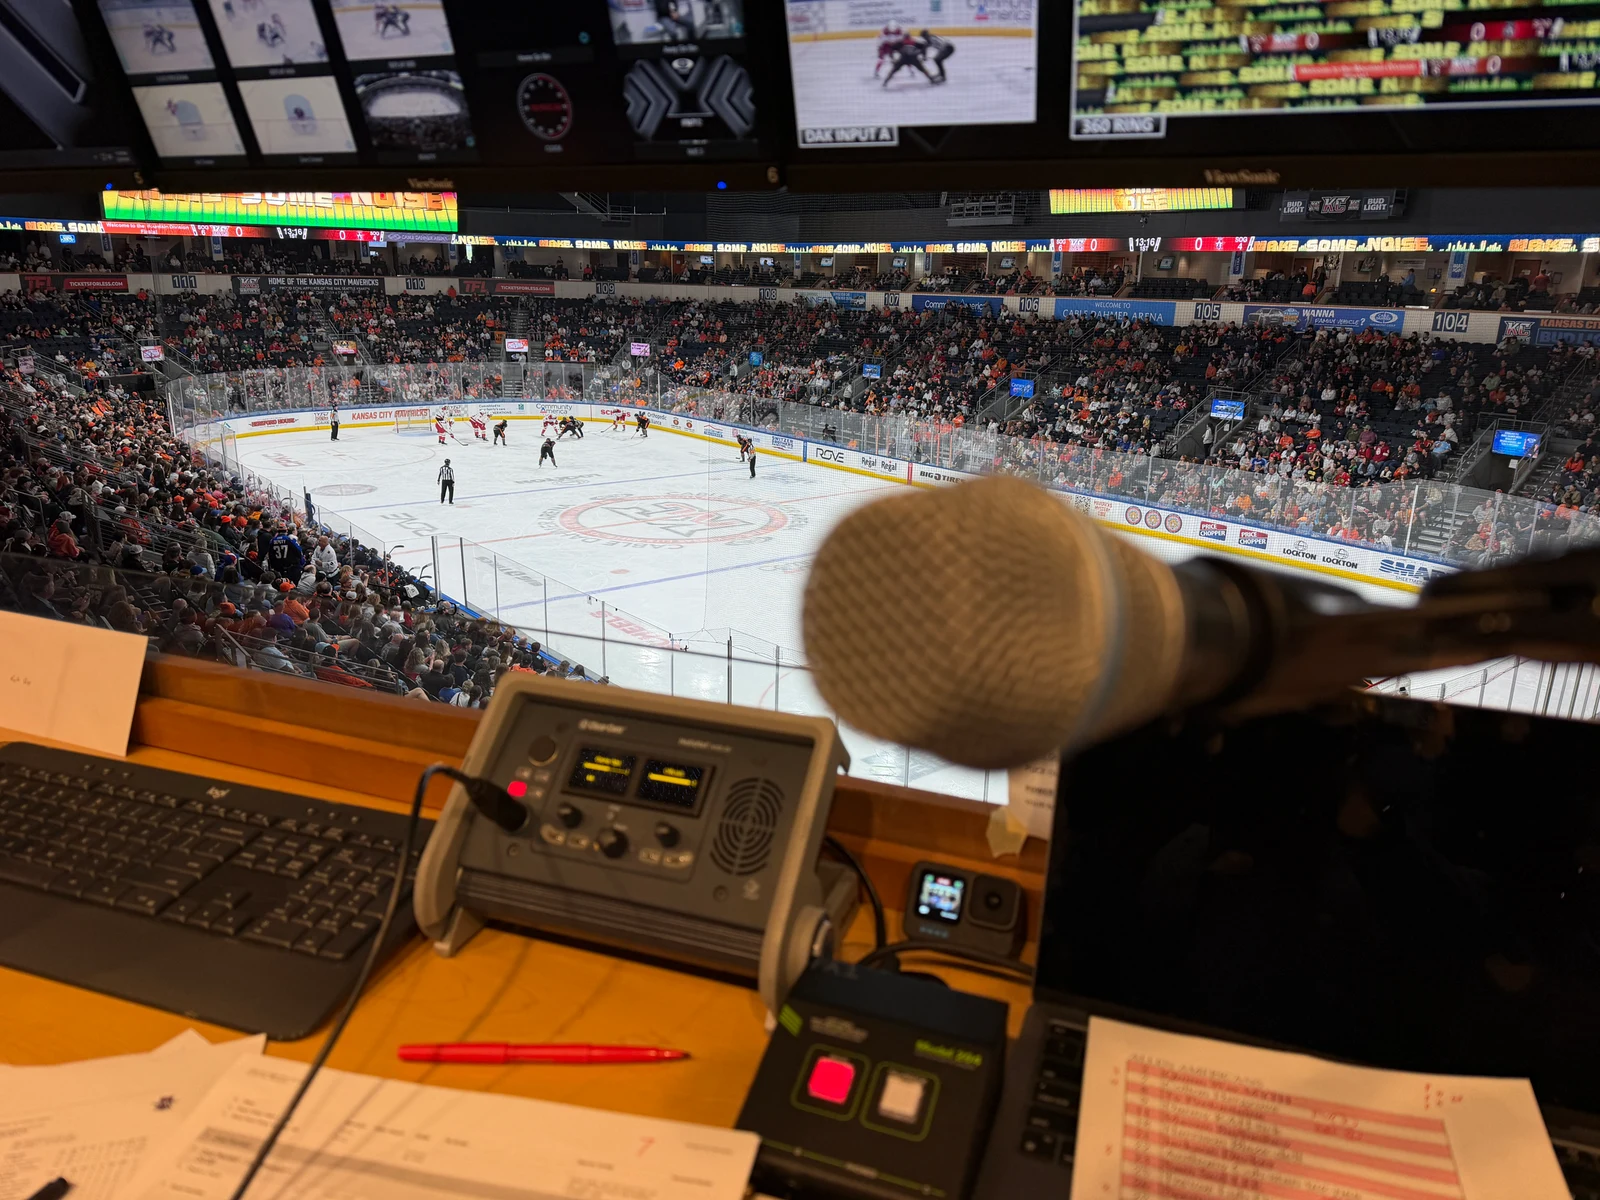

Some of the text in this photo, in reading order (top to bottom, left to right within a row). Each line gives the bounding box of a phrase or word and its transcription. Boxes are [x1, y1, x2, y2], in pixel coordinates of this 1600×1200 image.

[1081, 118, 1154, 133] 360 RING
[804, 126, 891, 143] DAK INPUT A
[1204, 168, 1280, 185] ViewSonic
[1363, 203, 1388, 211] LIGHT
[1367, 197, 1385, 205] BUD
[1283, 206, 1305, 214] LIGHT
[236, 226, 243, 237] 0
[339, 230, 346, 240] 0
[457, 235, 495, 246] NOISE
[538, 239, 647, 250] MAKE SOME NOISE
[1090, 238, 1098, 251] 0
[1135, 238, 1155, 248] 13:16
[1194, 237, 1202, 251] 0
[1253, 237, 1429, 252] MAKE SOME NOISE
[1508, 238, 1573, 252] MAKE
[685, 243, 785, 253] MAKE SOME NOISE
[812, 243, 892, 253] MAKE SOME NOISE
[926, 241, 1026, 253] MAKE SOME NOISE
[172, 275, 197, 288] 111
[309, 278, 332, 286] KANSAS
[406, 278, 425, 290] 110
[463, 280, 488, 293] TFL
[596, 283, 615, 294] 109
[759, 288, 777, 300] 108
[884, 293, 899, 306] 107
[1020, 298, 1039, 312] 106
[1062, 309, 1164, 322] CABLE DAHMER ARENA
[1195, 303, 1221, 320] 105
[1302, 308, 1335, 318] WANNA
[1433, 314, 1468, 330] 104
[1540, 319, 1584, 329] KANSAS
[1504, 321, 1535, 337] KC
[1539, 331, 1572, 345] BUD
[536, 403, 573, 413] Community
[351, 409, 428, 420] KANSAS CITY MAVERICKS
[277, 417, 296, 426] HOUSE
[816, 448, 844, 464] ROVE
[861, 456, 877, 468] Regal
[880, 460, 898, 472] Regal
[919, 470, 934, 479] BIG
[1239, 537, 1267, 546] CHOPPER
[273, 545, 289, 559] 37
[1282, 548, 1317, 561] LOCKTON
[1322, 556, 1358, 569] LOCKTON
